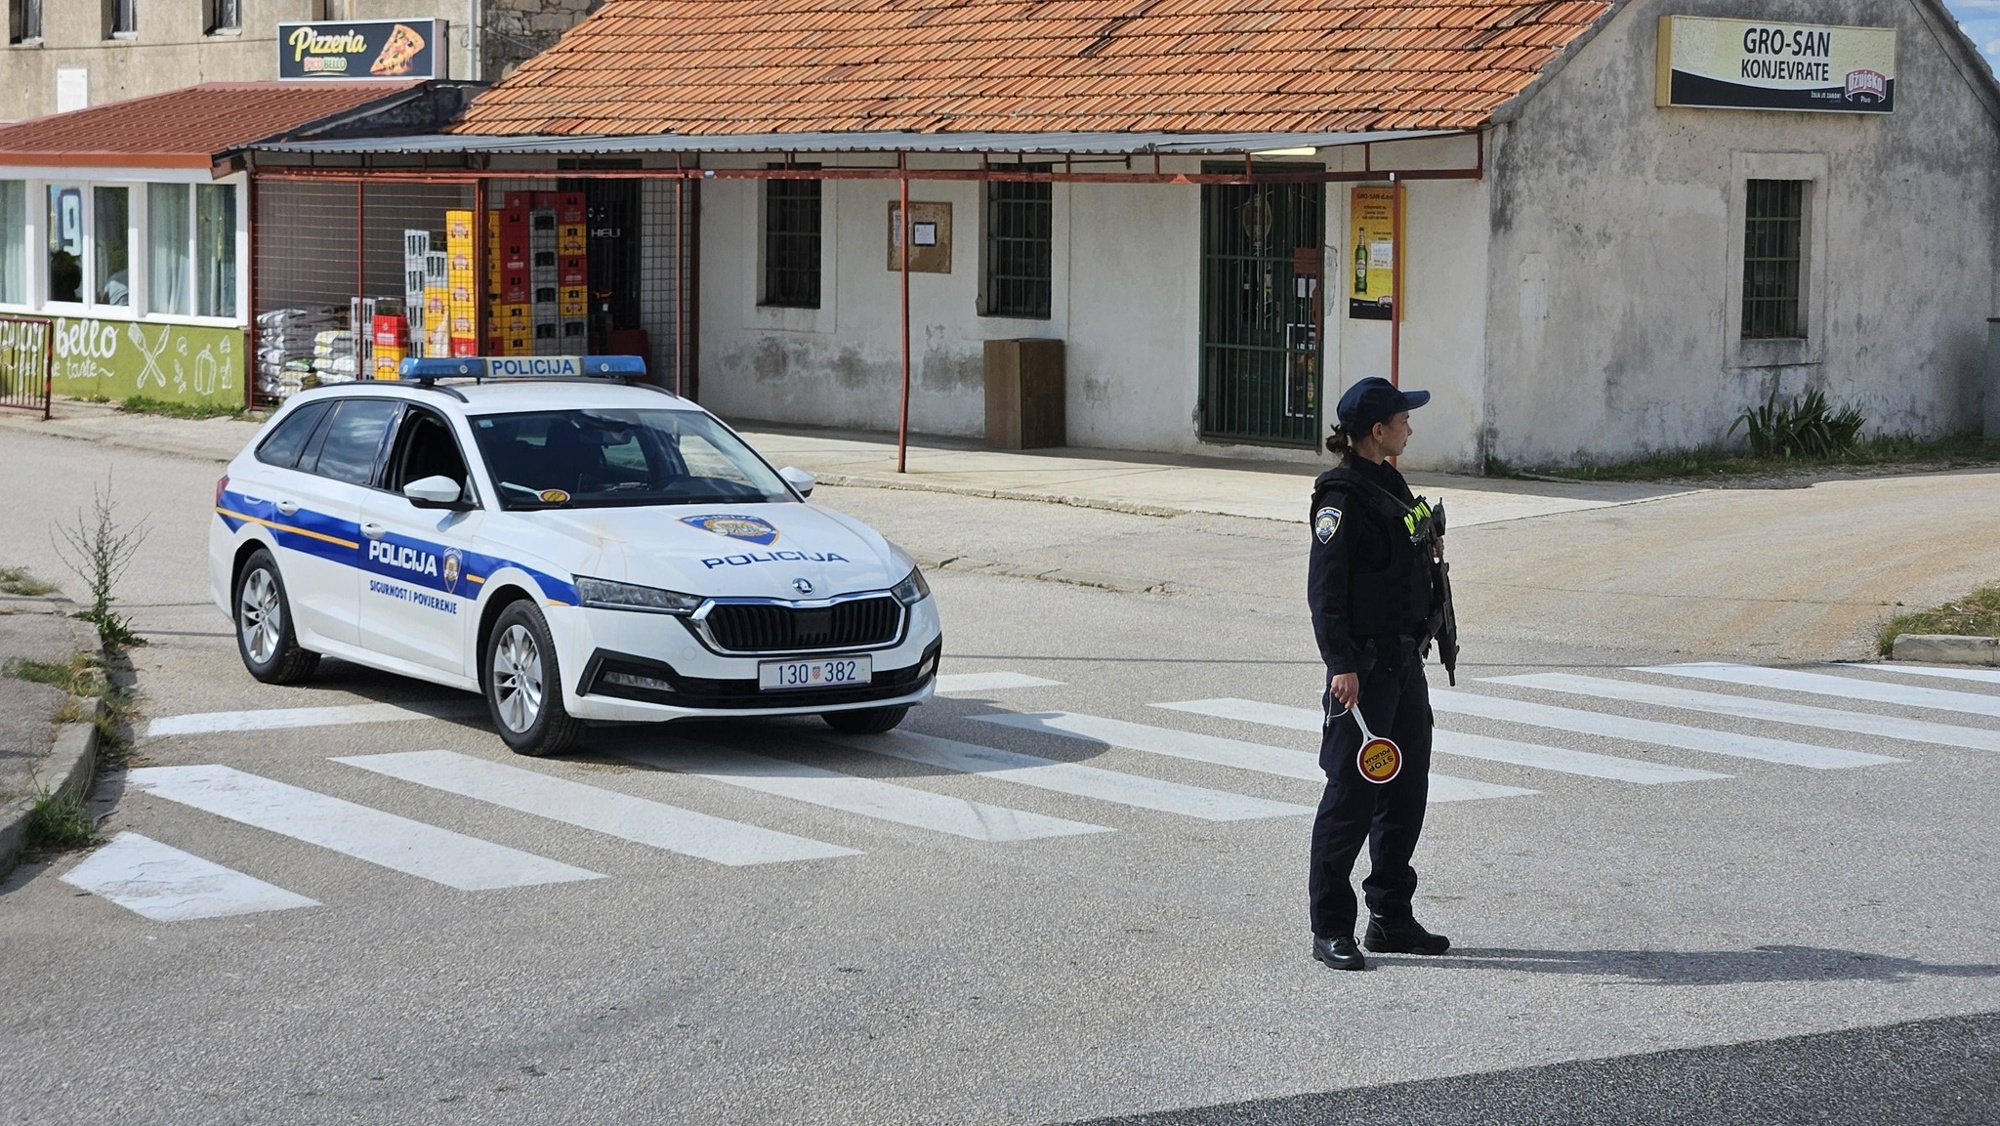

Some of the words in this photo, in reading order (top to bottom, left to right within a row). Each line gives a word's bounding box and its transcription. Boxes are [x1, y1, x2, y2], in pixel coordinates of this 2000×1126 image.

[288, 26, 368, 62] Pizzeria
[1743, 27, 1832, 58] GRO-SAN
[303, 57, 323, 72] PICO
[323, 57, 348, 72] BELLO
[1740, 59, 1830, 82] KONJEVRATE
[1847, 71, 1883, 92] Ožujsko
[56, 317, 119, 358] bello
[66, 357, 98, 380] taste
[492, 358, 576, 376] POLICIJA
[368, 539, 438, 577] POLICIJA
[701, 550, 850, 569] POLICIJA
[369, 580, 408, 600] SIGURNOST
[409, 590, 412, 602] I
[413, 592, 457, 615] POVJERENJE
[777, 663, 809, 685] 130
[823, 661, 856, 682] 382
[1364, 748, 1391, 764] POLICIJA
[1368, 755, 1394, 772] STOP
